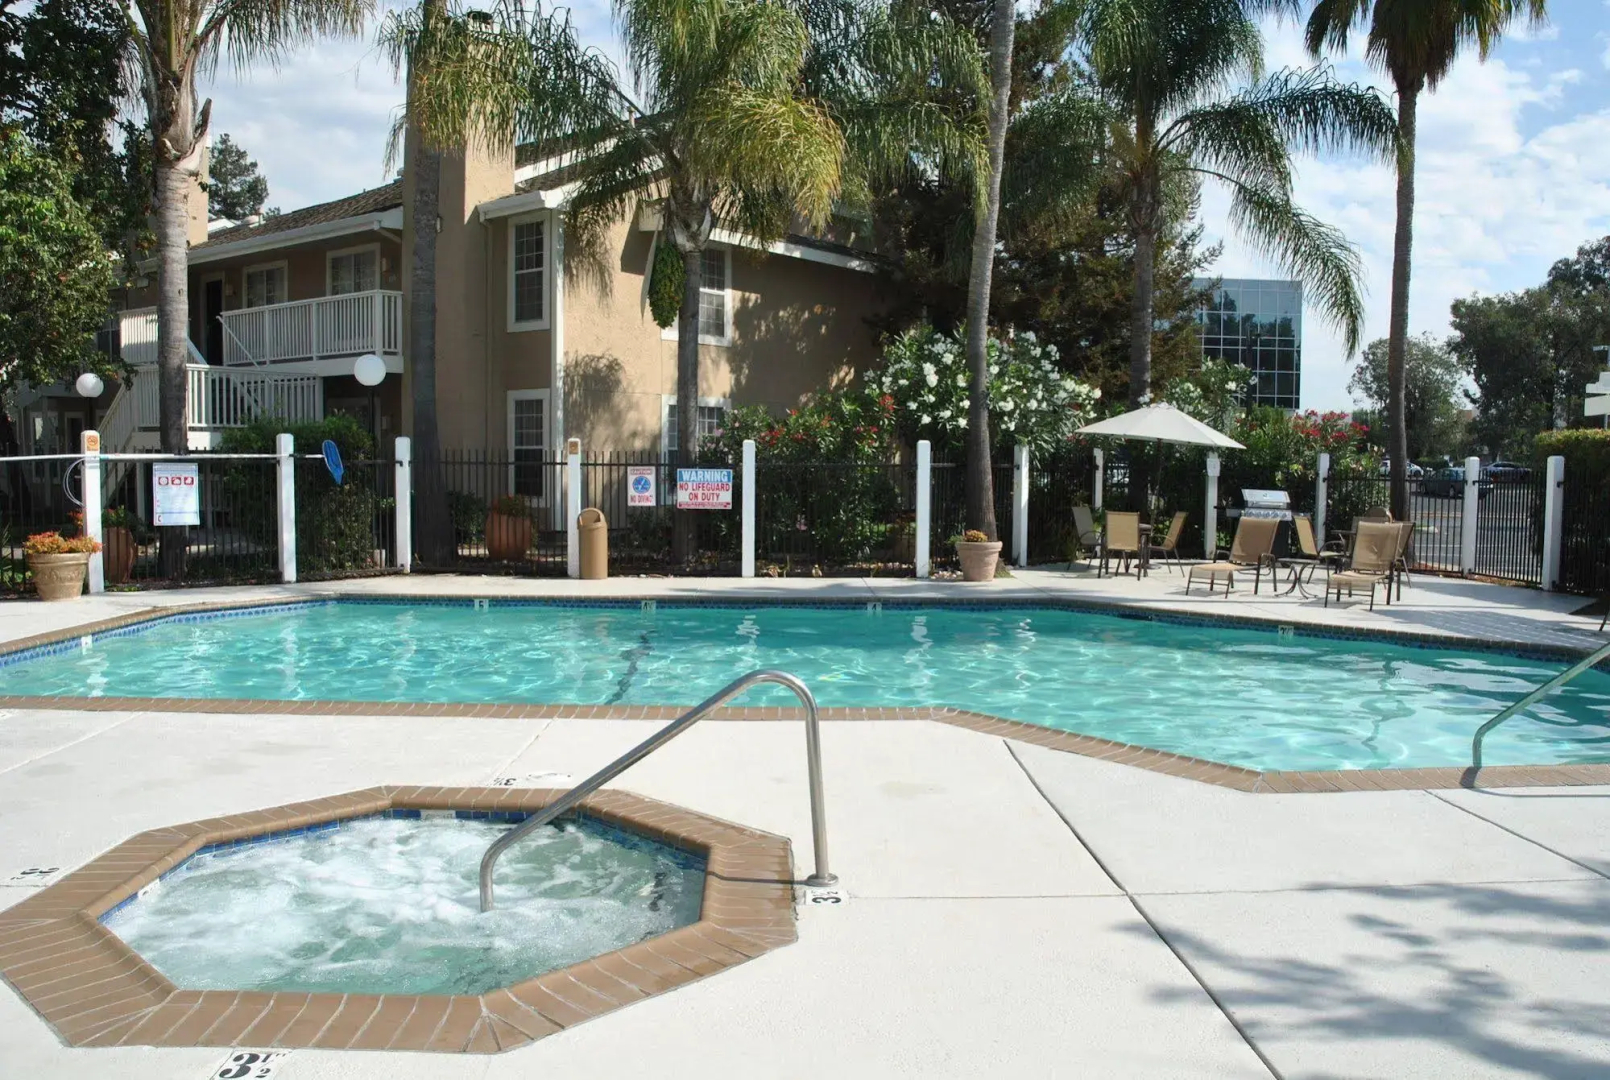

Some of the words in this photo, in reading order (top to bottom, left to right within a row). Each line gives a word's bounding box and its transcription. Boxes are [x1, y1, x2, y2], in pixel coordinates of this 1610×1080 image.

[682, 470, 728, 482] WARNING
[679, 482, 689, 491] NO
[692, 482, 730, 492] LIFEGUARD
[689, 492, 699, 501] ON
[702, 492, 720, 501] DUTY
